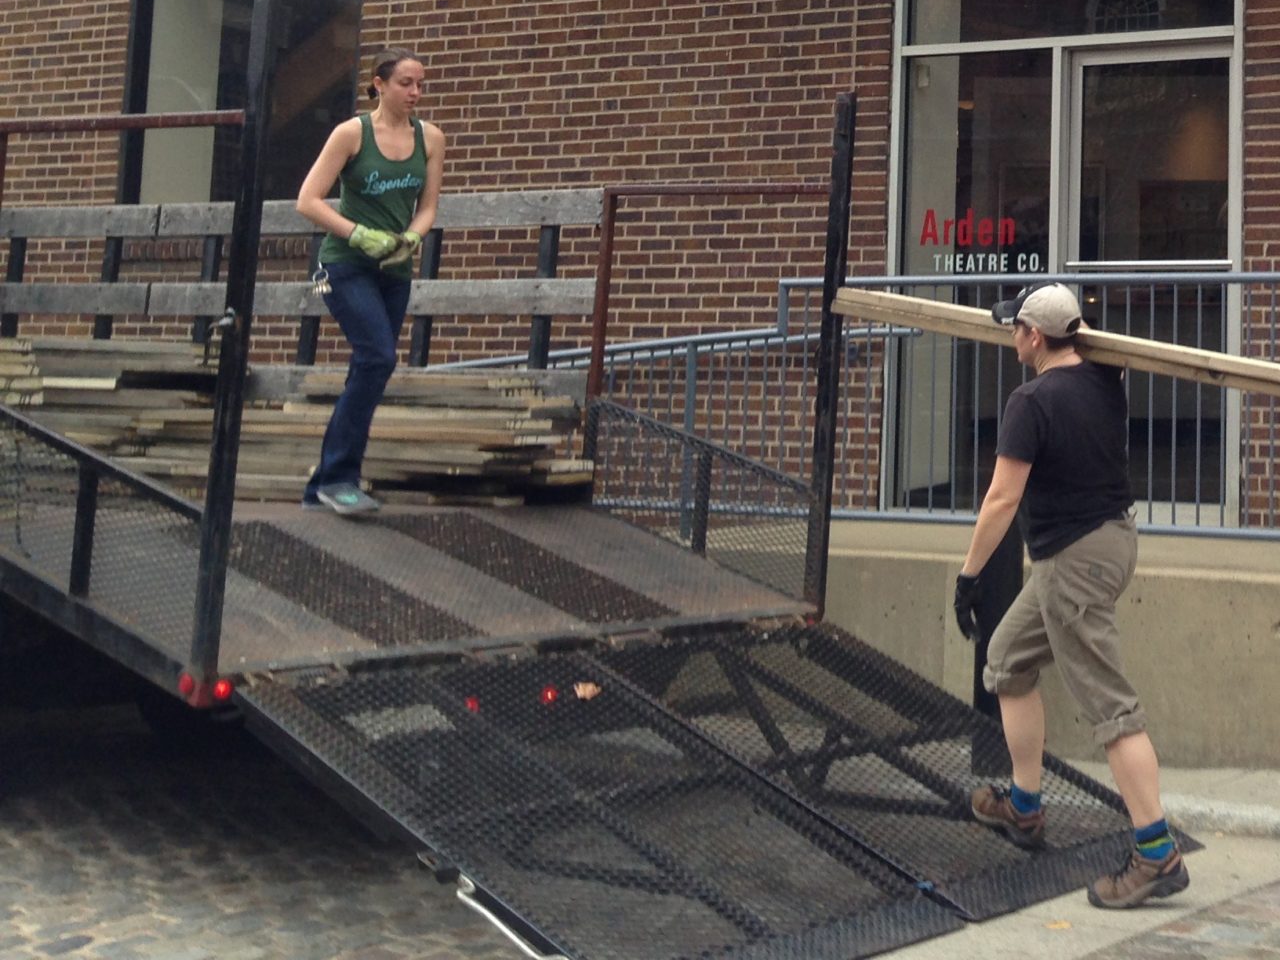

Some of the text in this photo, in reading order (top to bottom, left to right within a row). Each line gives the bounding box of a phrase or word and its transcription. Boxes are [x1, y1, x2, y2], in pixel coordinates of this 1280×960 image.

[920, 208, 1016, 246] Arden
[933, 253, 1045, 273] THEATRE CO.
